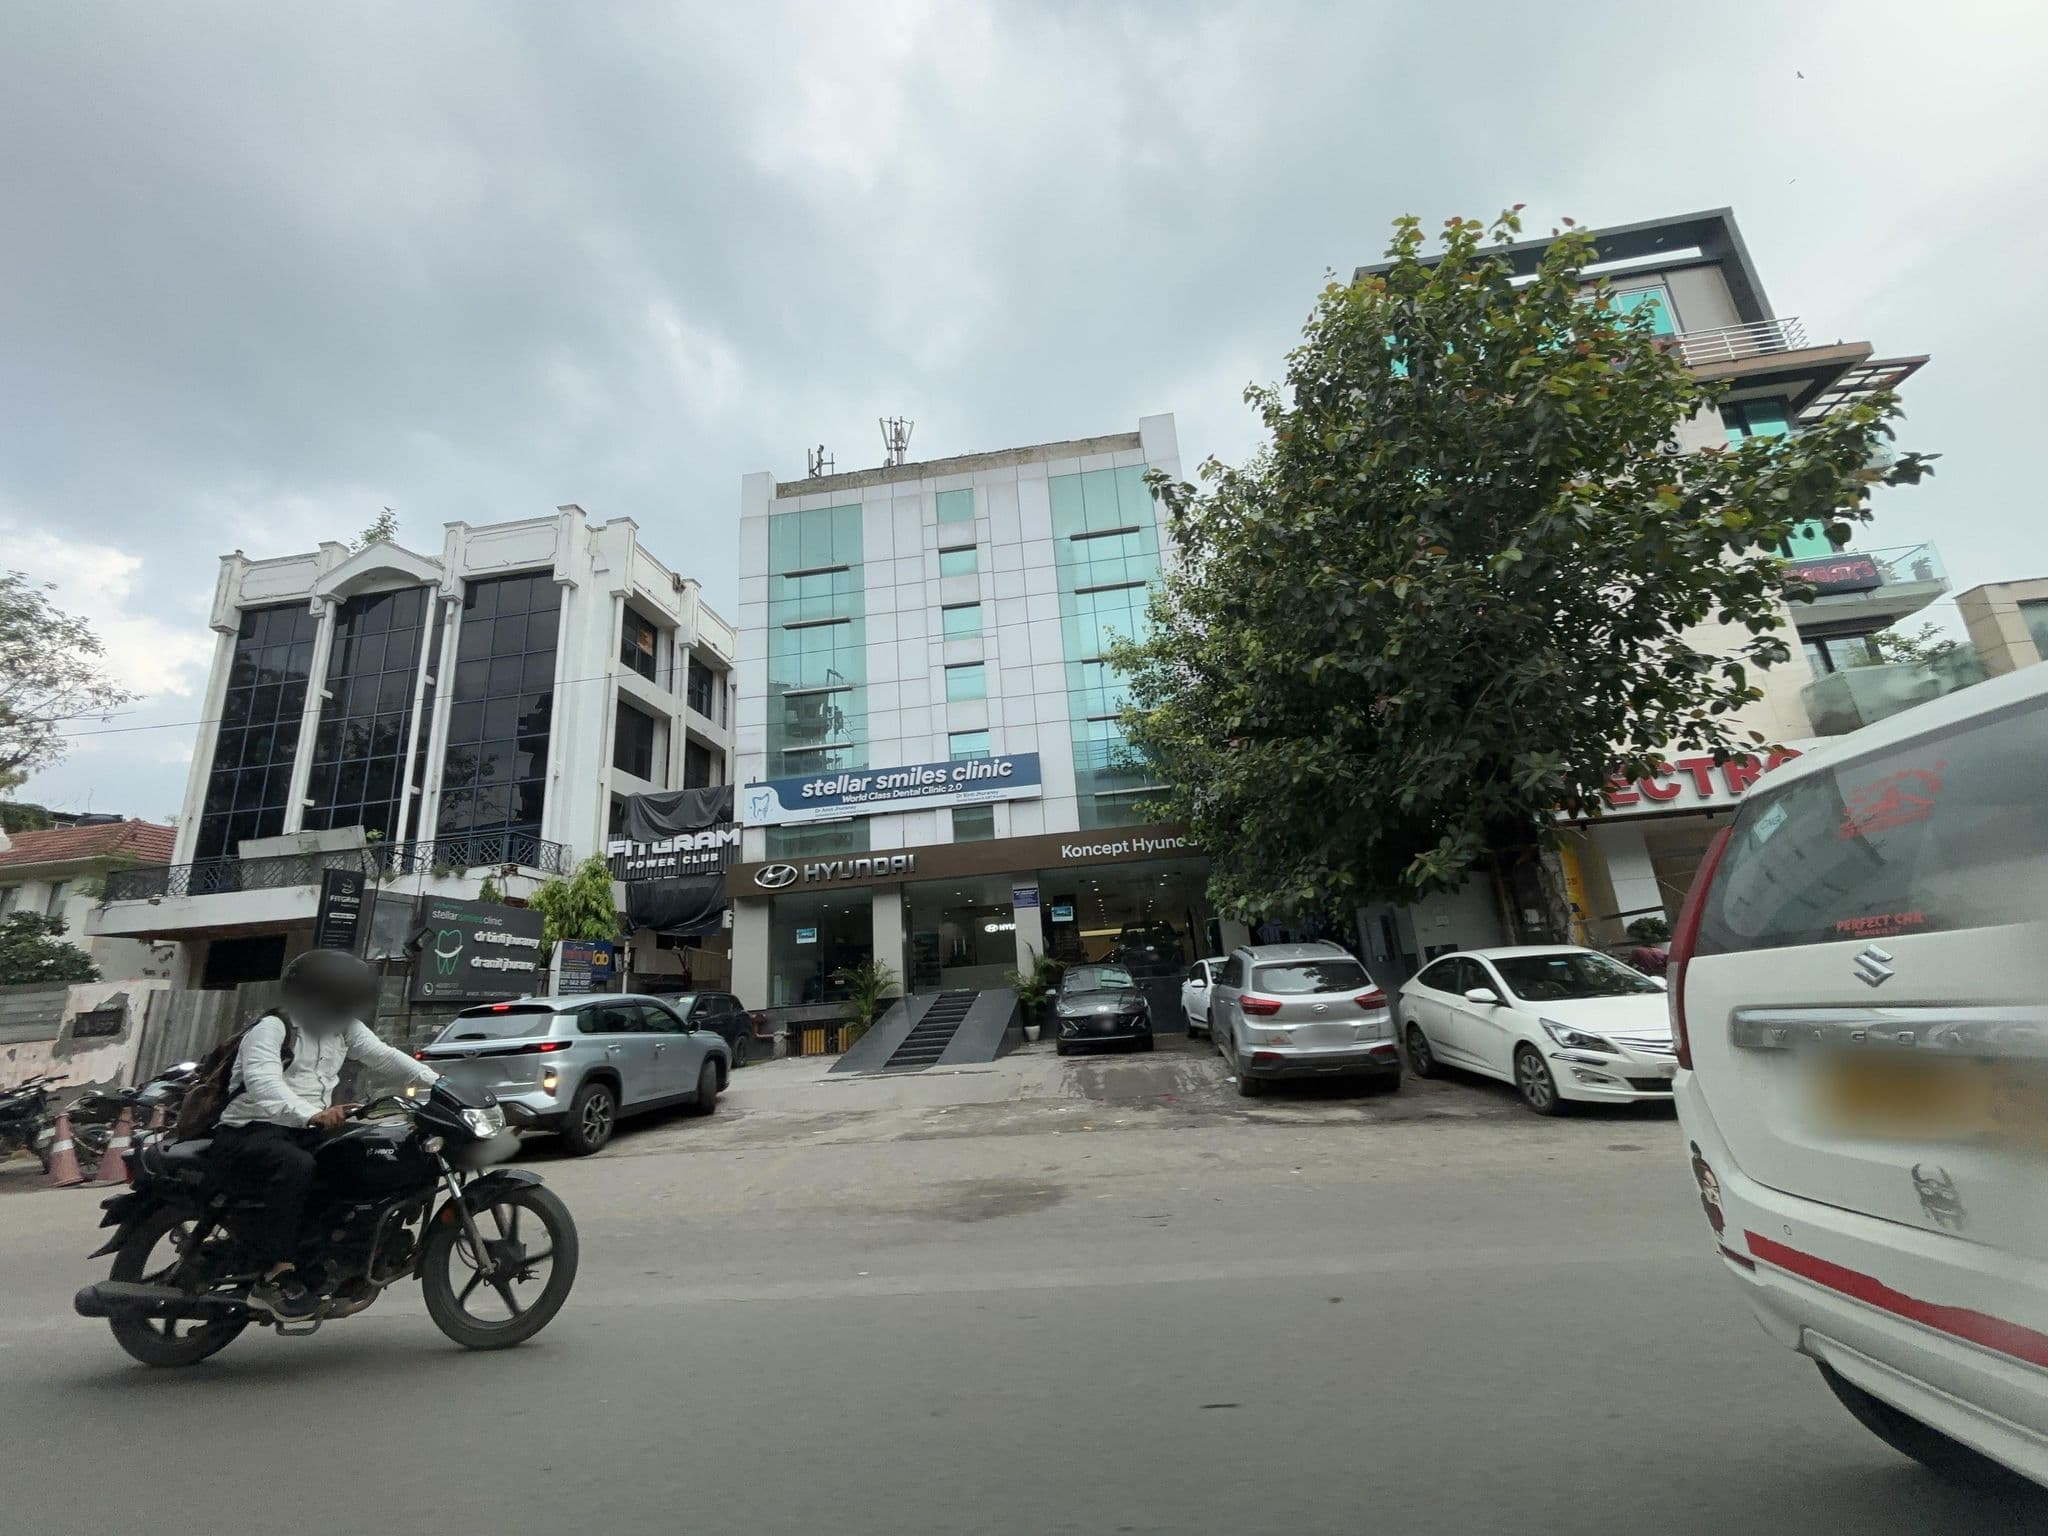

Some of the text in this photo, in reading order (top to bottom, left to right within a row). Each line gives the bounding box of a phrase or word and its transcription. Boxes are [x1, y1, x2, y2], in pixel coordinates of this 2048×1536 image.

[801, 758, 1013, 798] stellar smiles clinic
[842, 783, 962, 804] World Class Dental Clinic 2.0
[1061, 840, 1130, 859] Koncept
[627, 853, 719, 870] POWER CLUB
[803, 854, 916, 882] HYUNDAI
